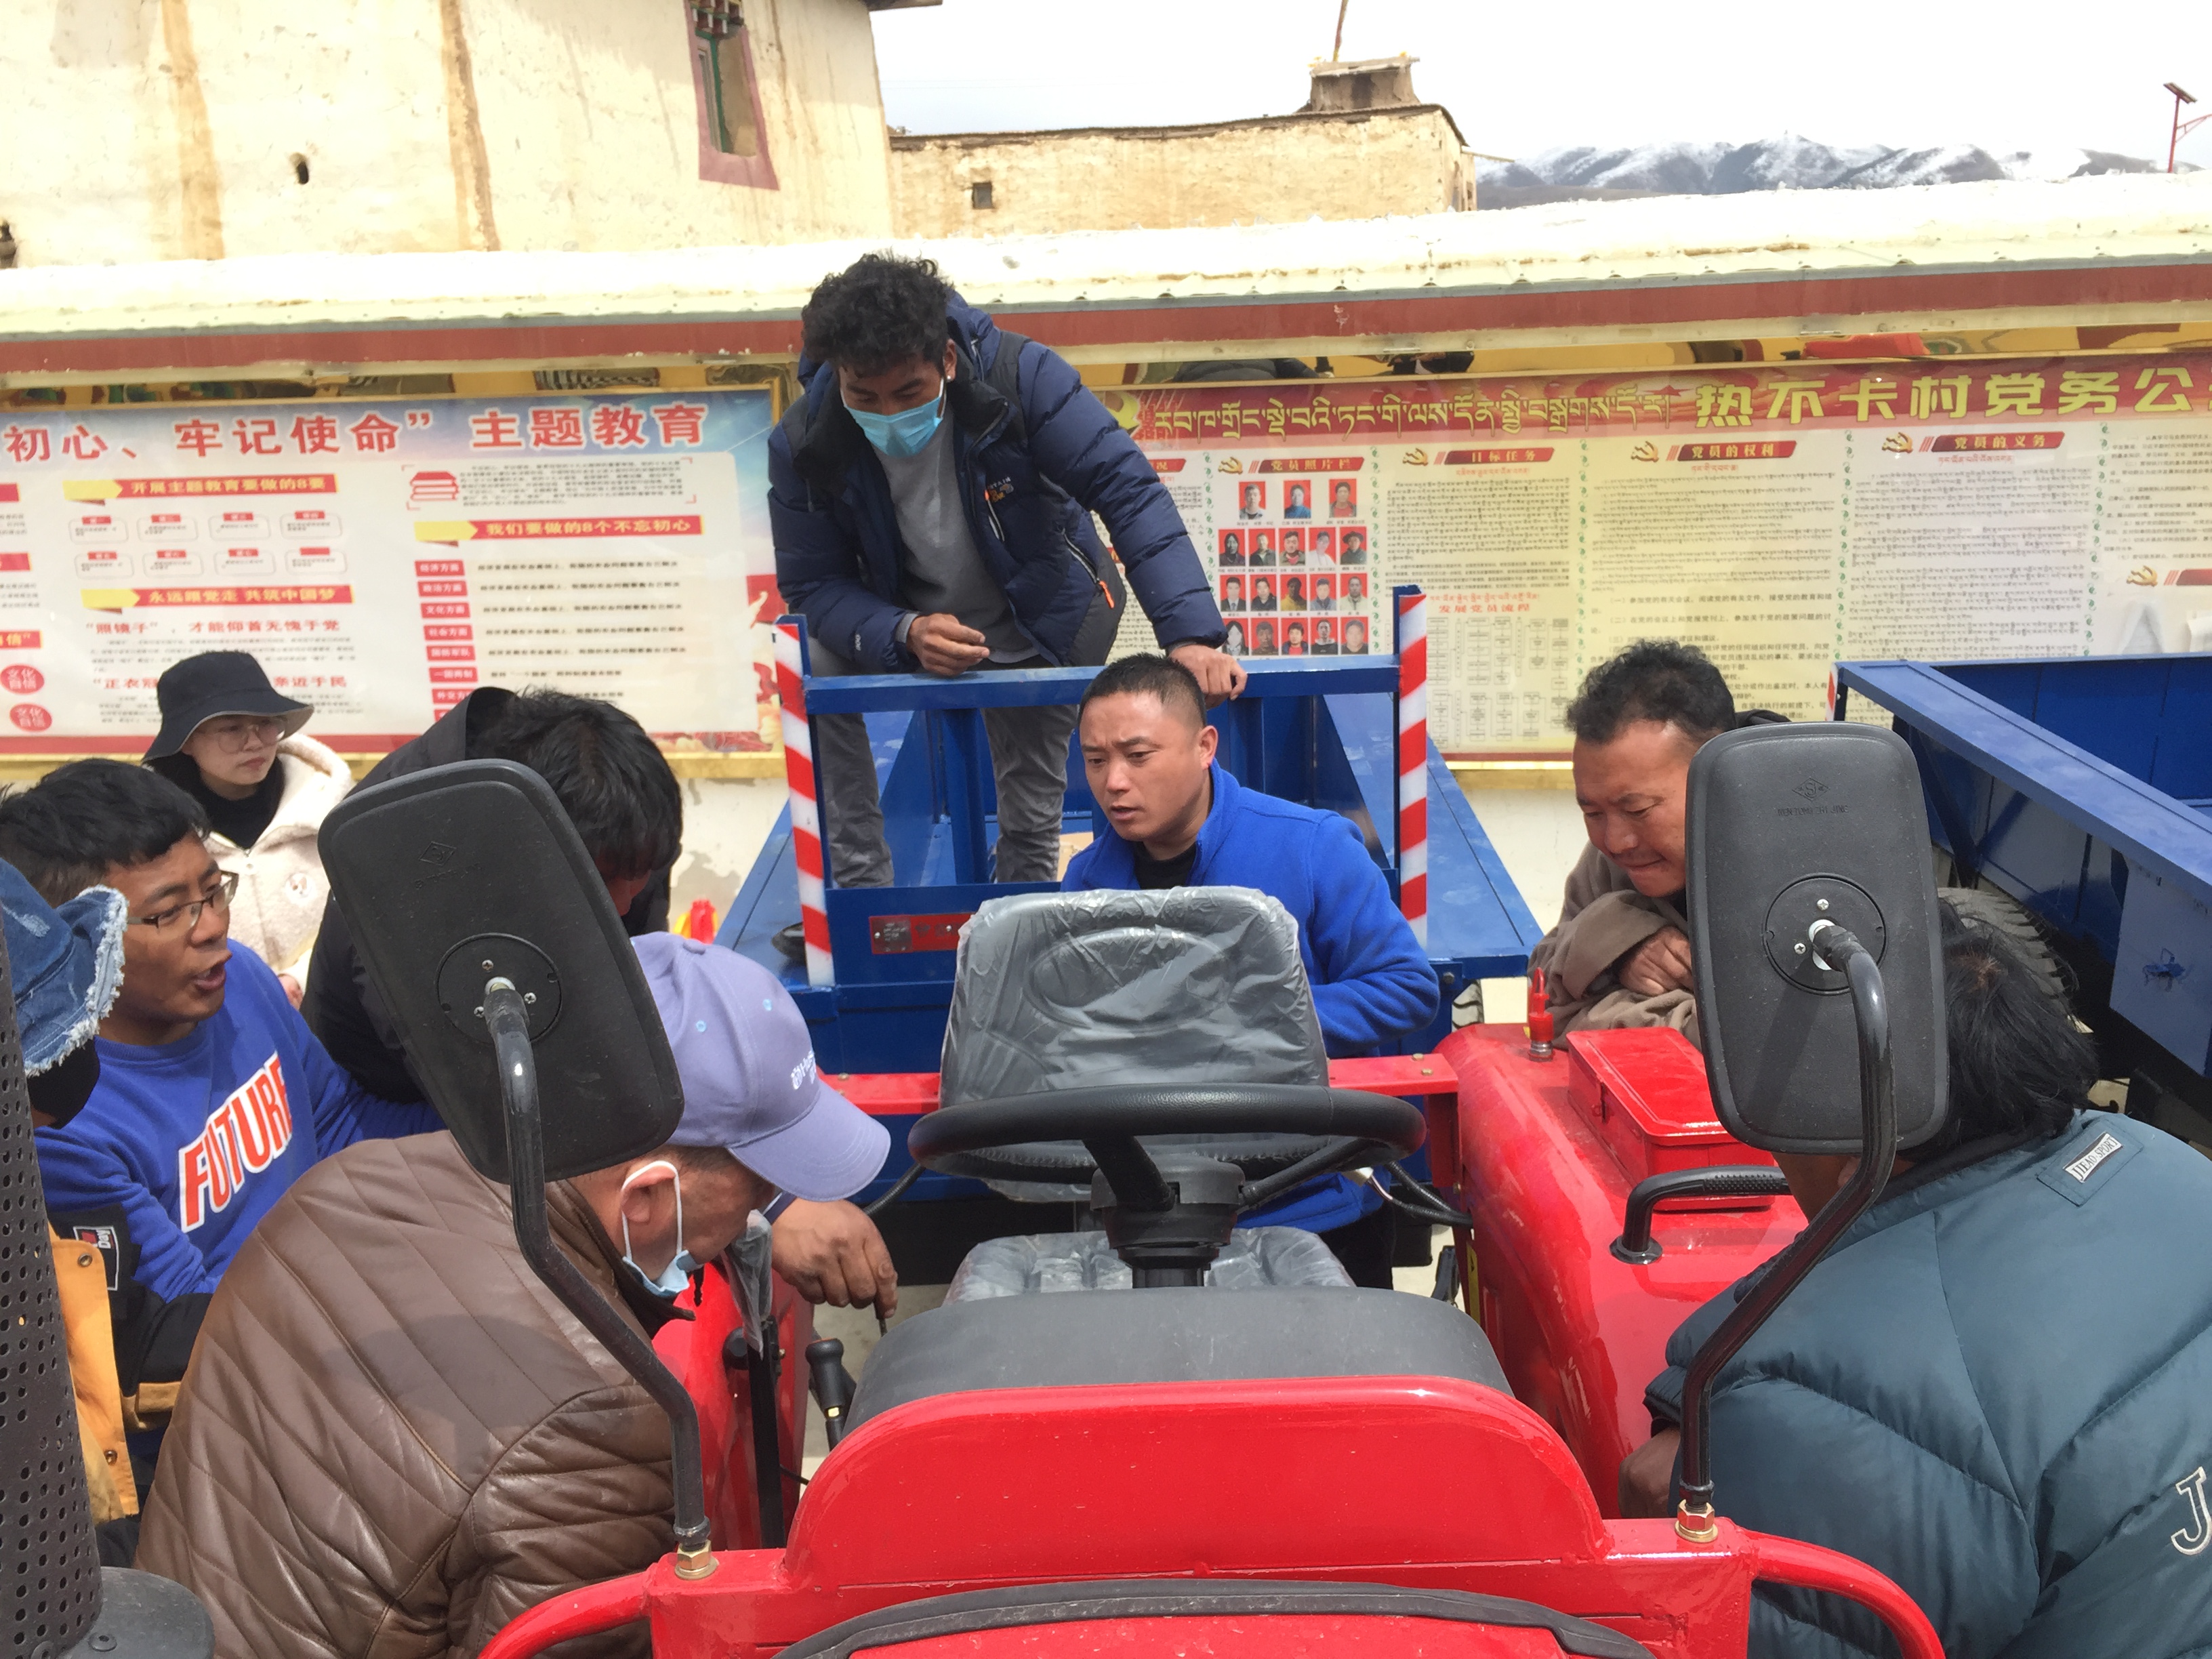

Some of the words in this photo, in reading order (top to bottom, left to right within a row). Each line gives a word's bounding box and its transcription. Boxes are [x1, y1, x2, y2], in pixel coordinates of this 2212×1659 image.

[1696, 367, 2212, 428] 热不卡村党务公
[1954, 434, 2046, 449] 党员的义务
[1471, 449, 1536, 462] 目标任务
[1692, 444, 1774, 458] 党员的权利
[1271, 458, 1351, 470] 党员照片栏
[486, 520, 691, 536] 我们要做的8个不忘初心
[1439, 603, 1530, 613] 发展党员流程
[178, 1050, 293, 1233] FUTURE
